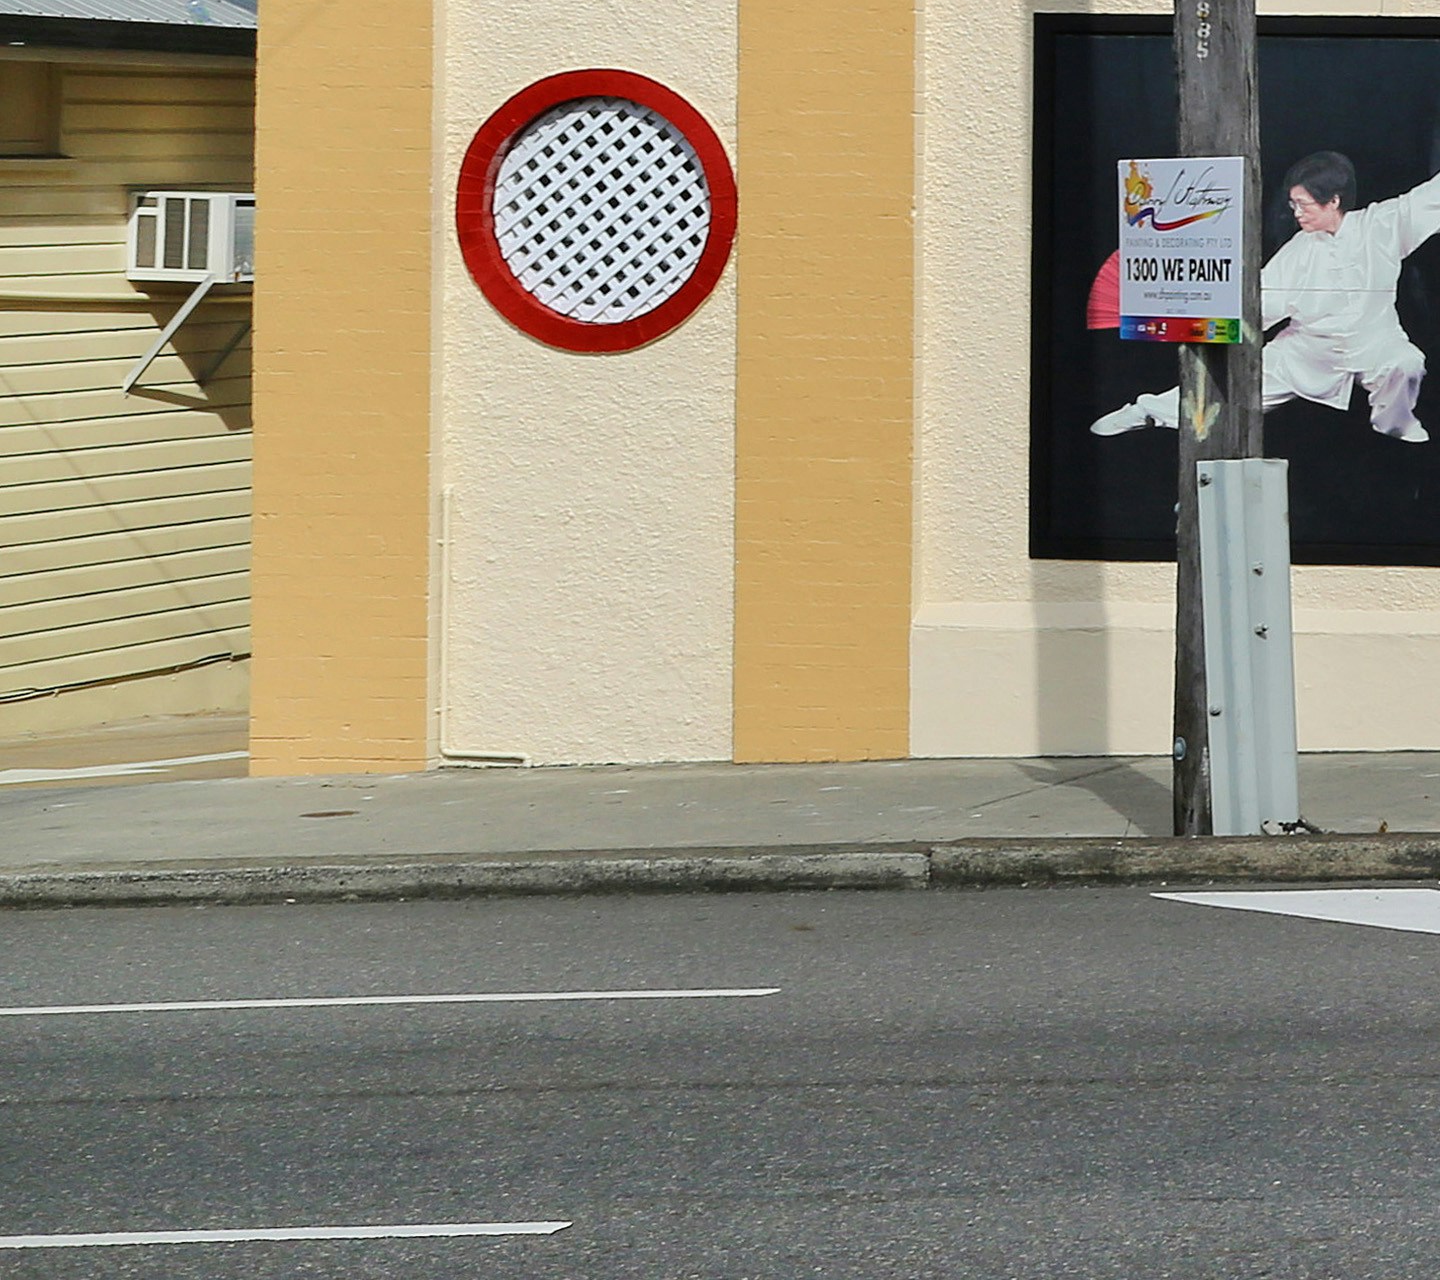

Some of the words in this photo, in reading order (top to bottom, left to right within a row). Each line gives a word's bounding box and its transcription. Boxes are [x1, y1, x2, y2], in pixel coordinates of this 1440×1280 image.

[1126, 257, 1158, 282] 1300
[1162, 258, 1184, 282] WE
[1189, 258, 1232, 282] PAINT
